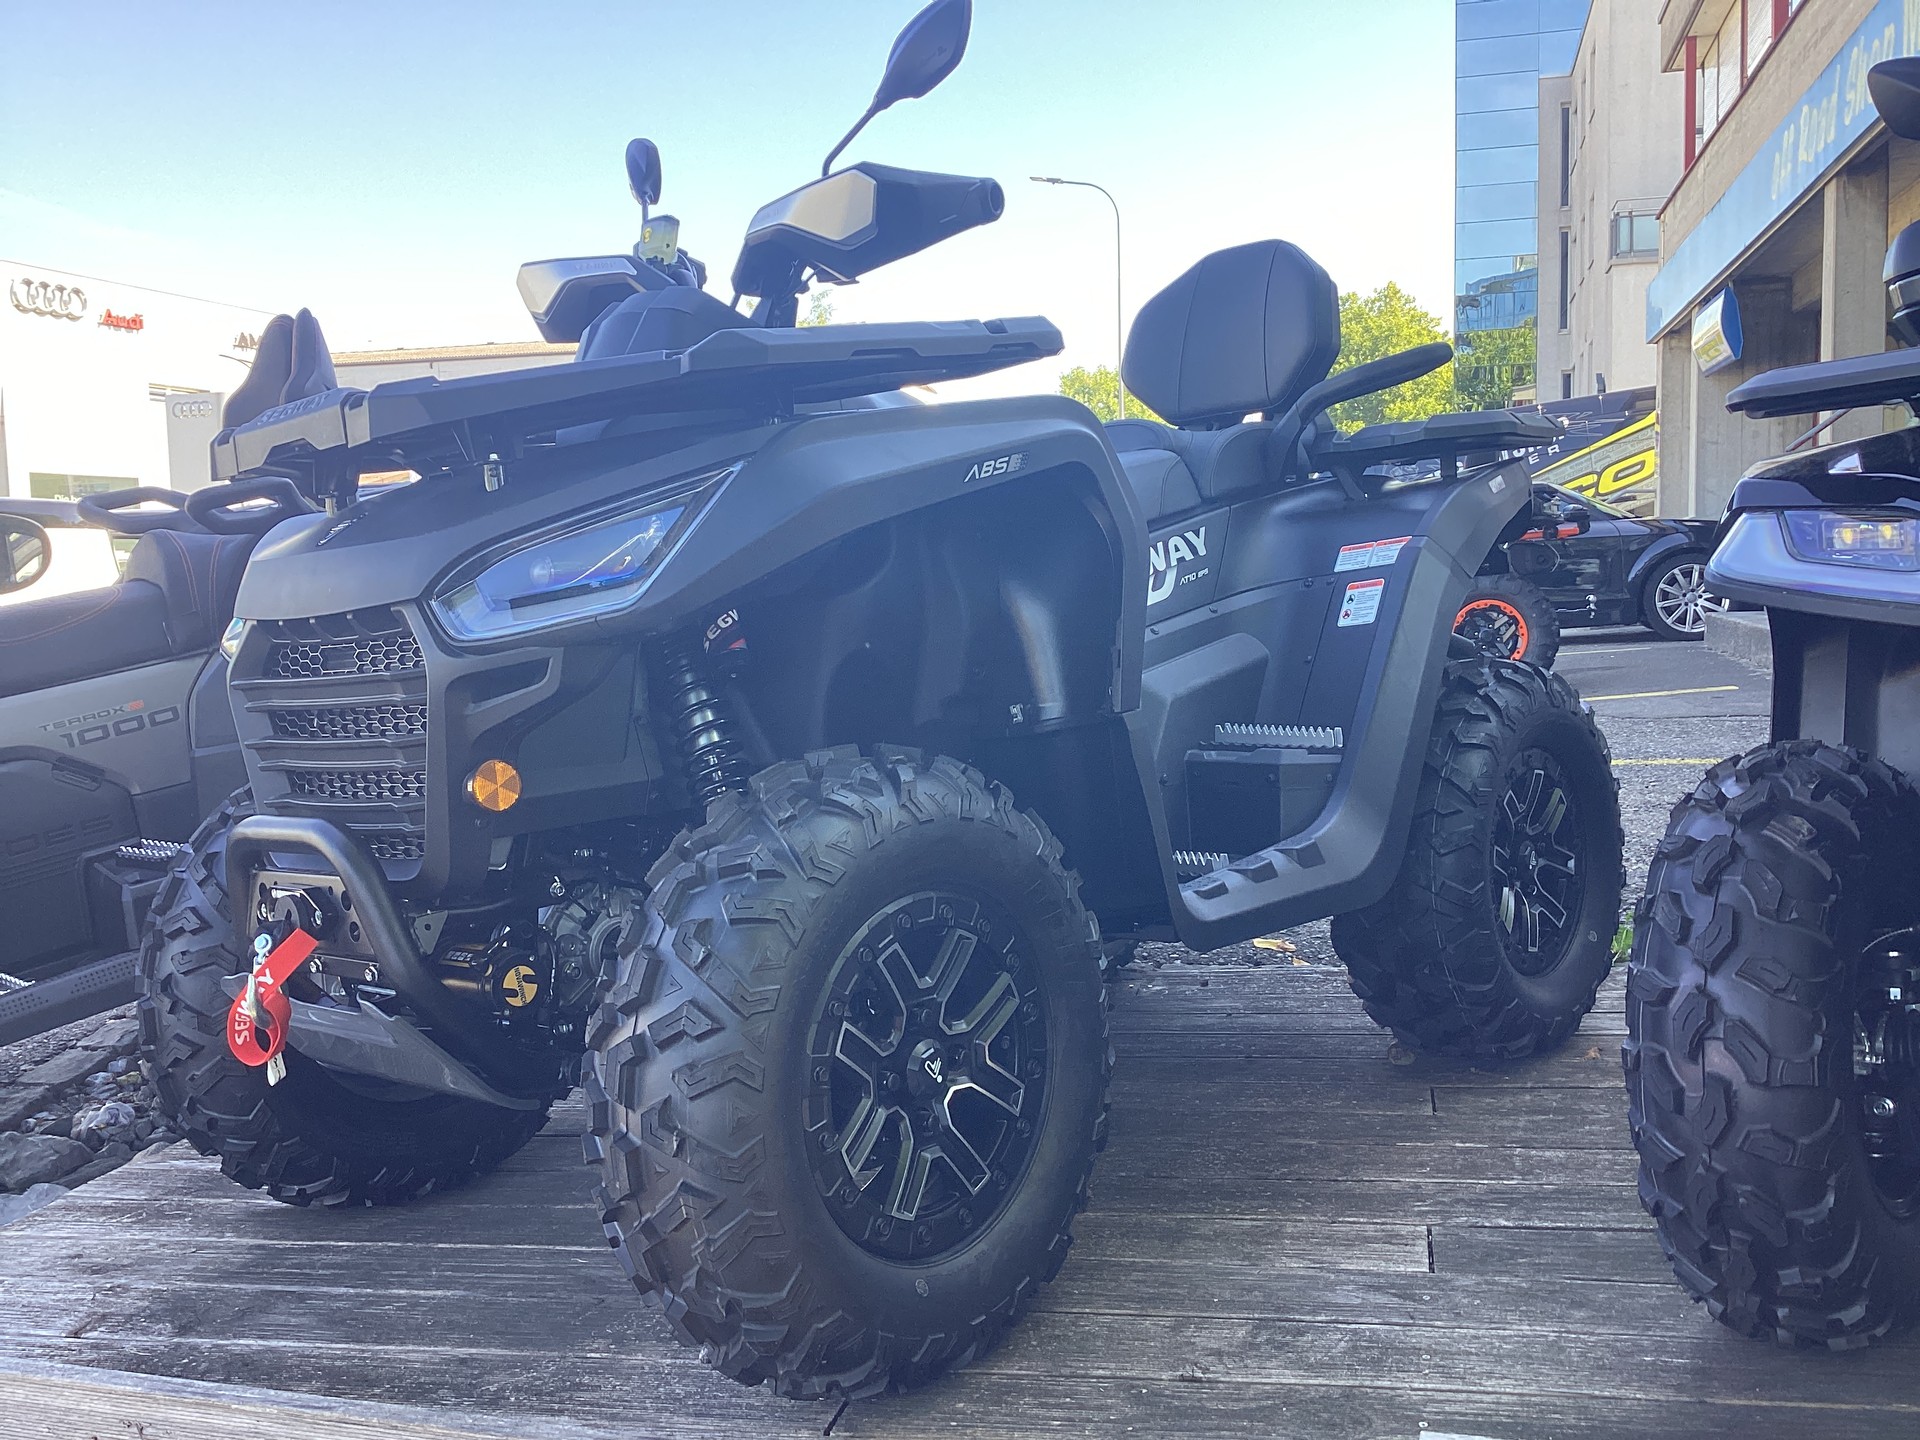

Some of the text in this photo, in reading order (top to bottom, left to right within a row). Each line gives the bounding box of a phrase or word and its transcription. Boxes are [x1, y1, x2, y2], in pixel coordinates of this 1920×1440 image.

[1798, 64, 1841, 165] Road
[101, 308, 144, 331] Audi
[963, 456, 1010, 483] ABS
[59, 705, 181, 748] 1000
